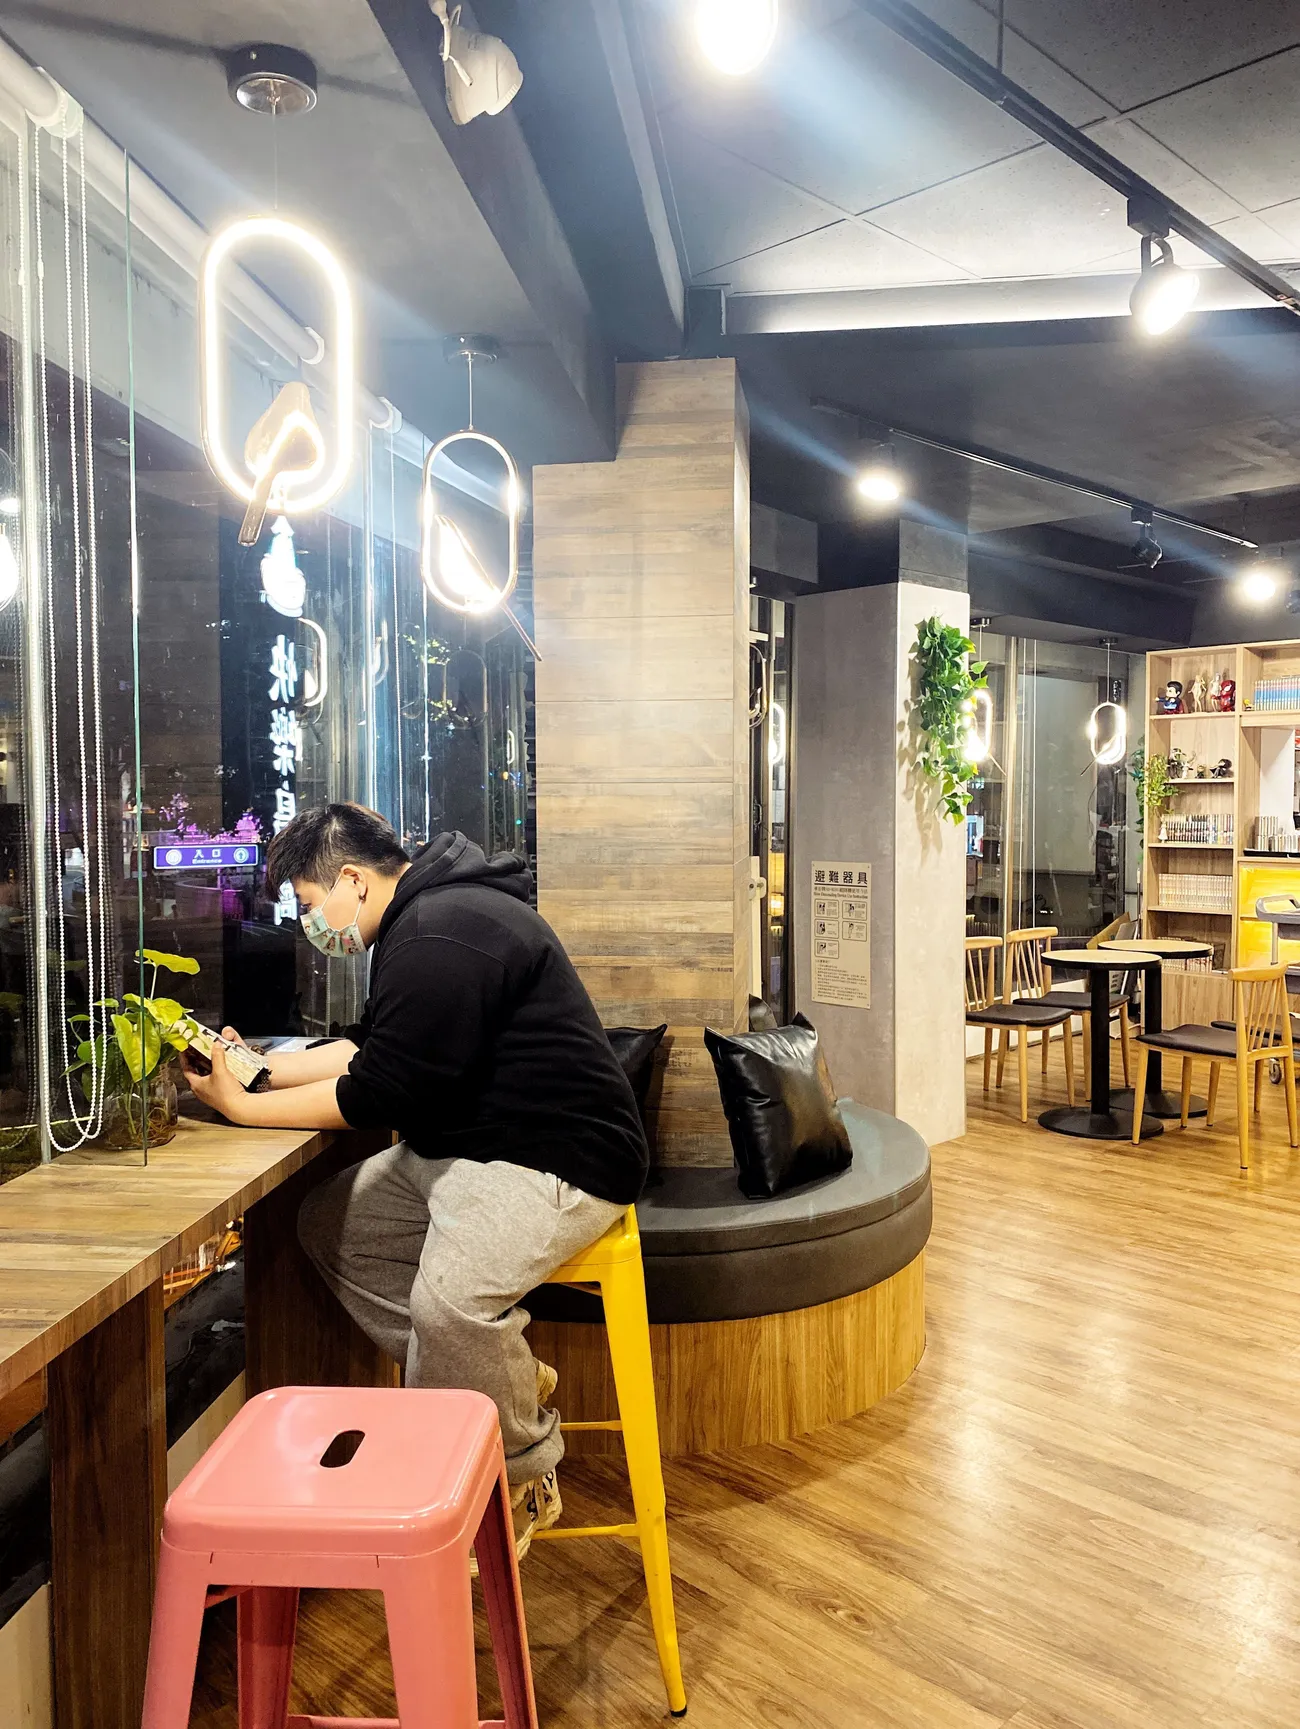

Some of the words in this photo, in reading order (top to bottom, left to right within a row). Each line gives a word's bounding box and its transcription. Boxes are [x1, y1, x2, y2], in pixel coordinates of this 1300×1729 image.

[193, 848, 221, 858] 入口
[814, 869, 868, 885] 避難器具
